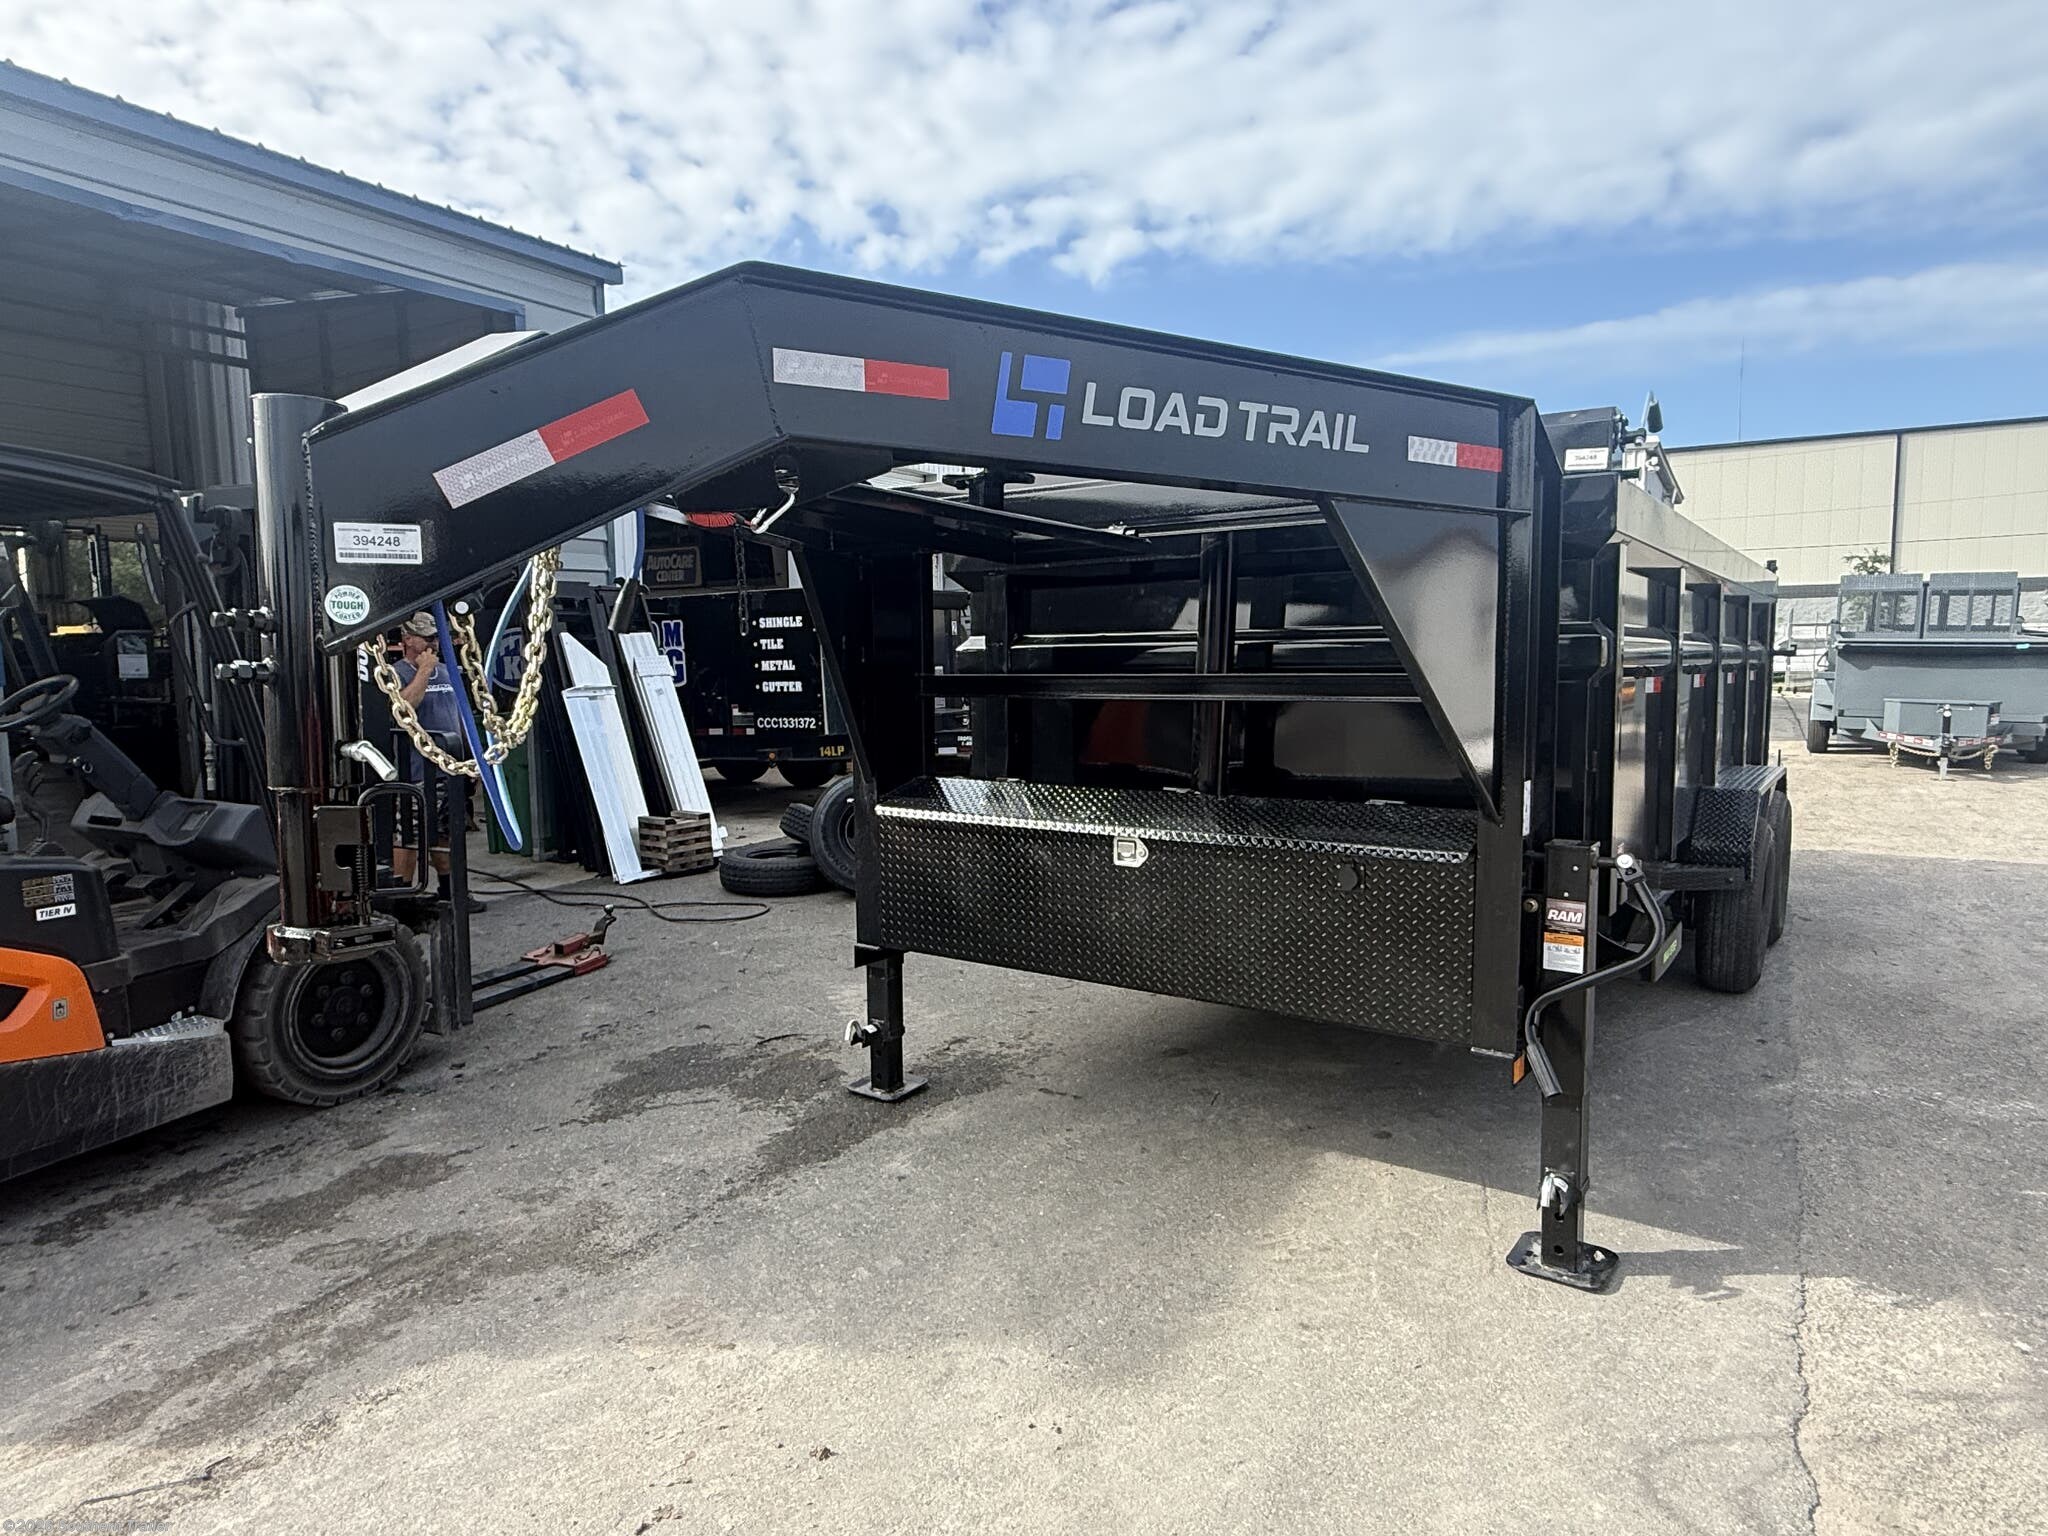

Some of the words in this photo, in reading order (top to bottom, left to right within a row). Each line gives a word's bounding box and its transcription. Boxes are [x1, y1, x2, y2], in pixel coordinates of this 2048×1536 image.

[1082, 382, 1229, 438] LOAD
[1239, 401, 1370, 454] TRAIL
[353, 535, 401, 547] 394248
[656, 570, 685, 582] CENTER
[334, 590, 361, 600] POWDER
[330, 600, 364, 610] TOUGH
[335, 611, 361, 620] COATED
[759, 616, 803, 628] SHINGLE
[760, 638, 784, 650] TILE
[761, 660, 796, 671] METAL
[762, 681, 803, 692] GUTTER
[757, 717, 816, 729] CCC1331372
[819, 745, 845, 757] 14LP
[40, 909, 61, 919] TIER
[64, 906, 73, 914] IV
[1547, 909, 1583, 923] RAM
